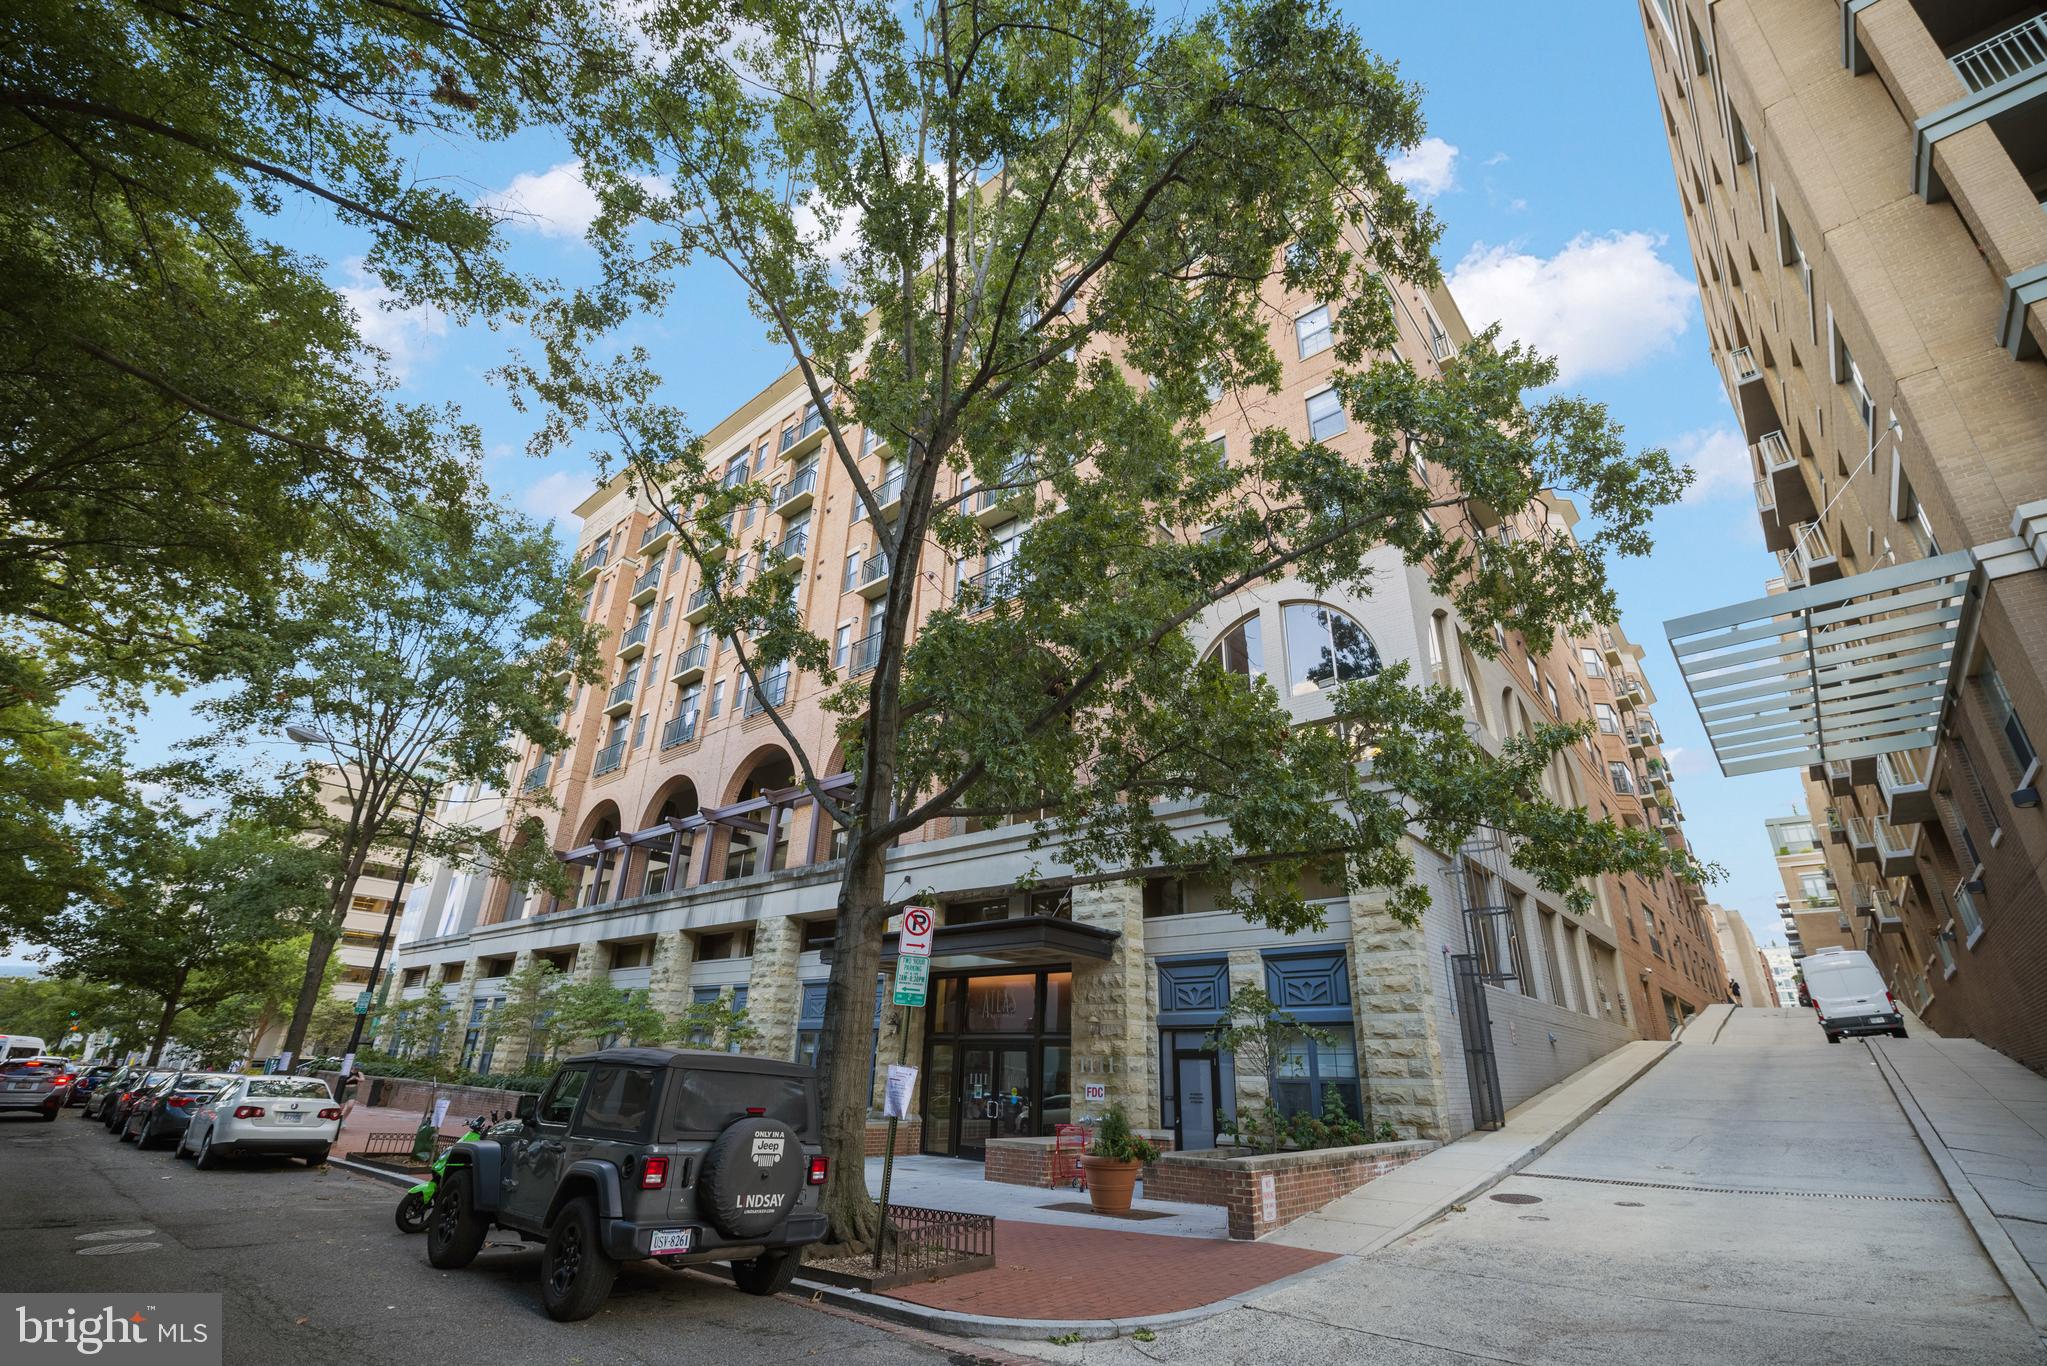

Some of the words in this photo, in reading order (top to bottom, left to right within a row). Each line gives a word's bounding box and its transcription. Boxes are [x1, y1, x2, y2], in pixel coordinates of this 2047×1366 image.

[1087, 1086, 1103, 1098] FDC
[754, 1130, 772, 1138] ONLY
[757, 1140, 779, 1152] Jeep
[736, 1193, 785, 1208] LINDSAY
